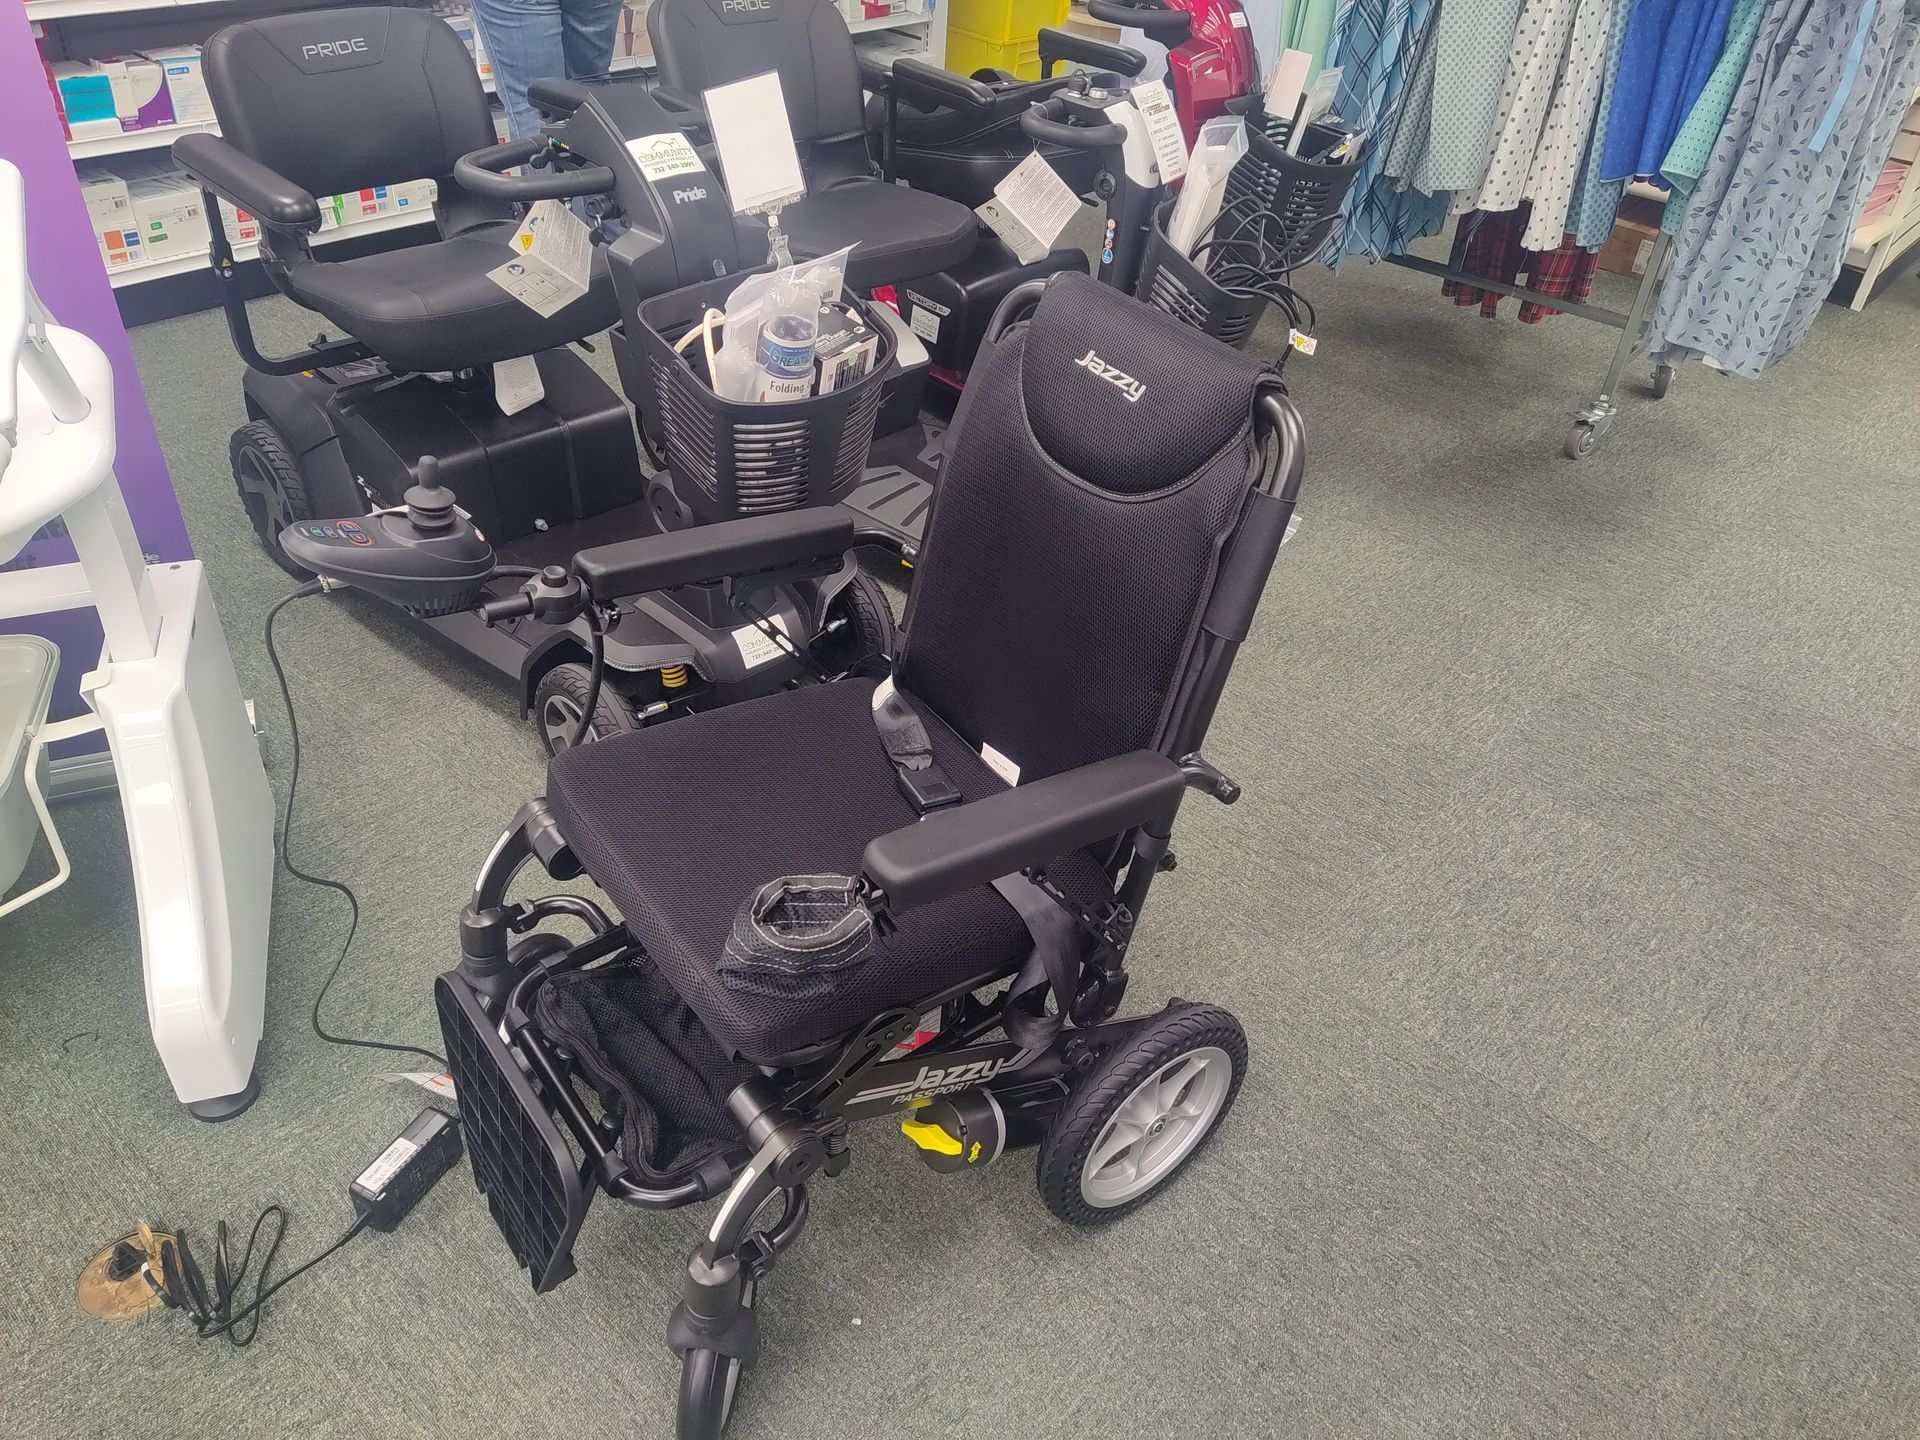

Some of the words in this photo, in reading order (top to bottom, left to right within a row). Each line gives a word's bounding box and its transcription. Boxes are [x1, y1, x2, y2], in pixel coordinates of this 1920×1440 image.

[721, 0, 771, 13] PRIDE
[302, 37, 369, 60] PRIDE
[639, 147, 693, 164] COMMUNITY
[672, 186, 708, 205] Pride
[1074, 350, 1147, 402] Jazzy
[770, 380, 804, 394] Folding
[899, 1058, 1005, 1094] Jazzy
[891, 1080, 975, 1105] PASSPORT
